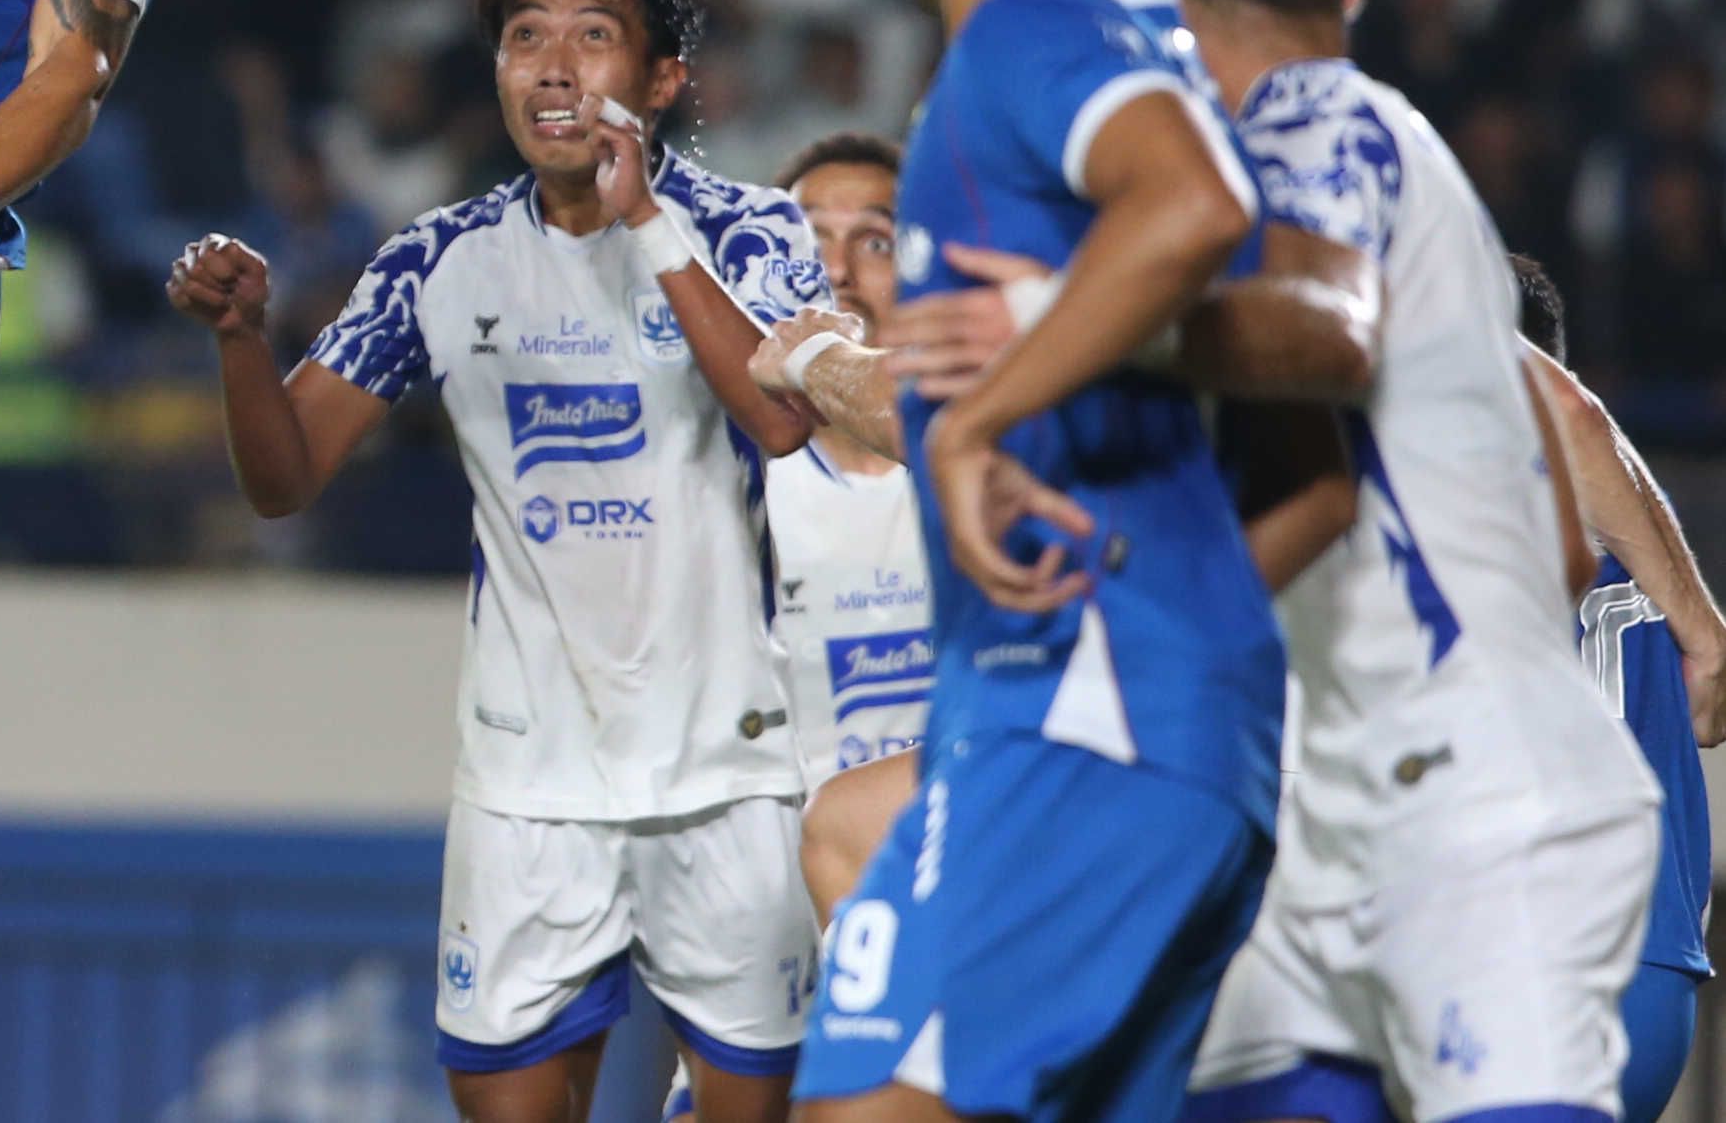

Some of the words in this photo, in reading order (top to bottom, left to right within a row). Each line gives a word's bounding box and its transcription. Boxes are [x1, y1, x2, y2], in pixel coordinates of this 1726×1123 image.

[560, 315, 585, 337] Le
[517, 334, 612, 357] Minerale
[567, 497, 654, 526] DRX
[875, 567, 900, 588] Le
